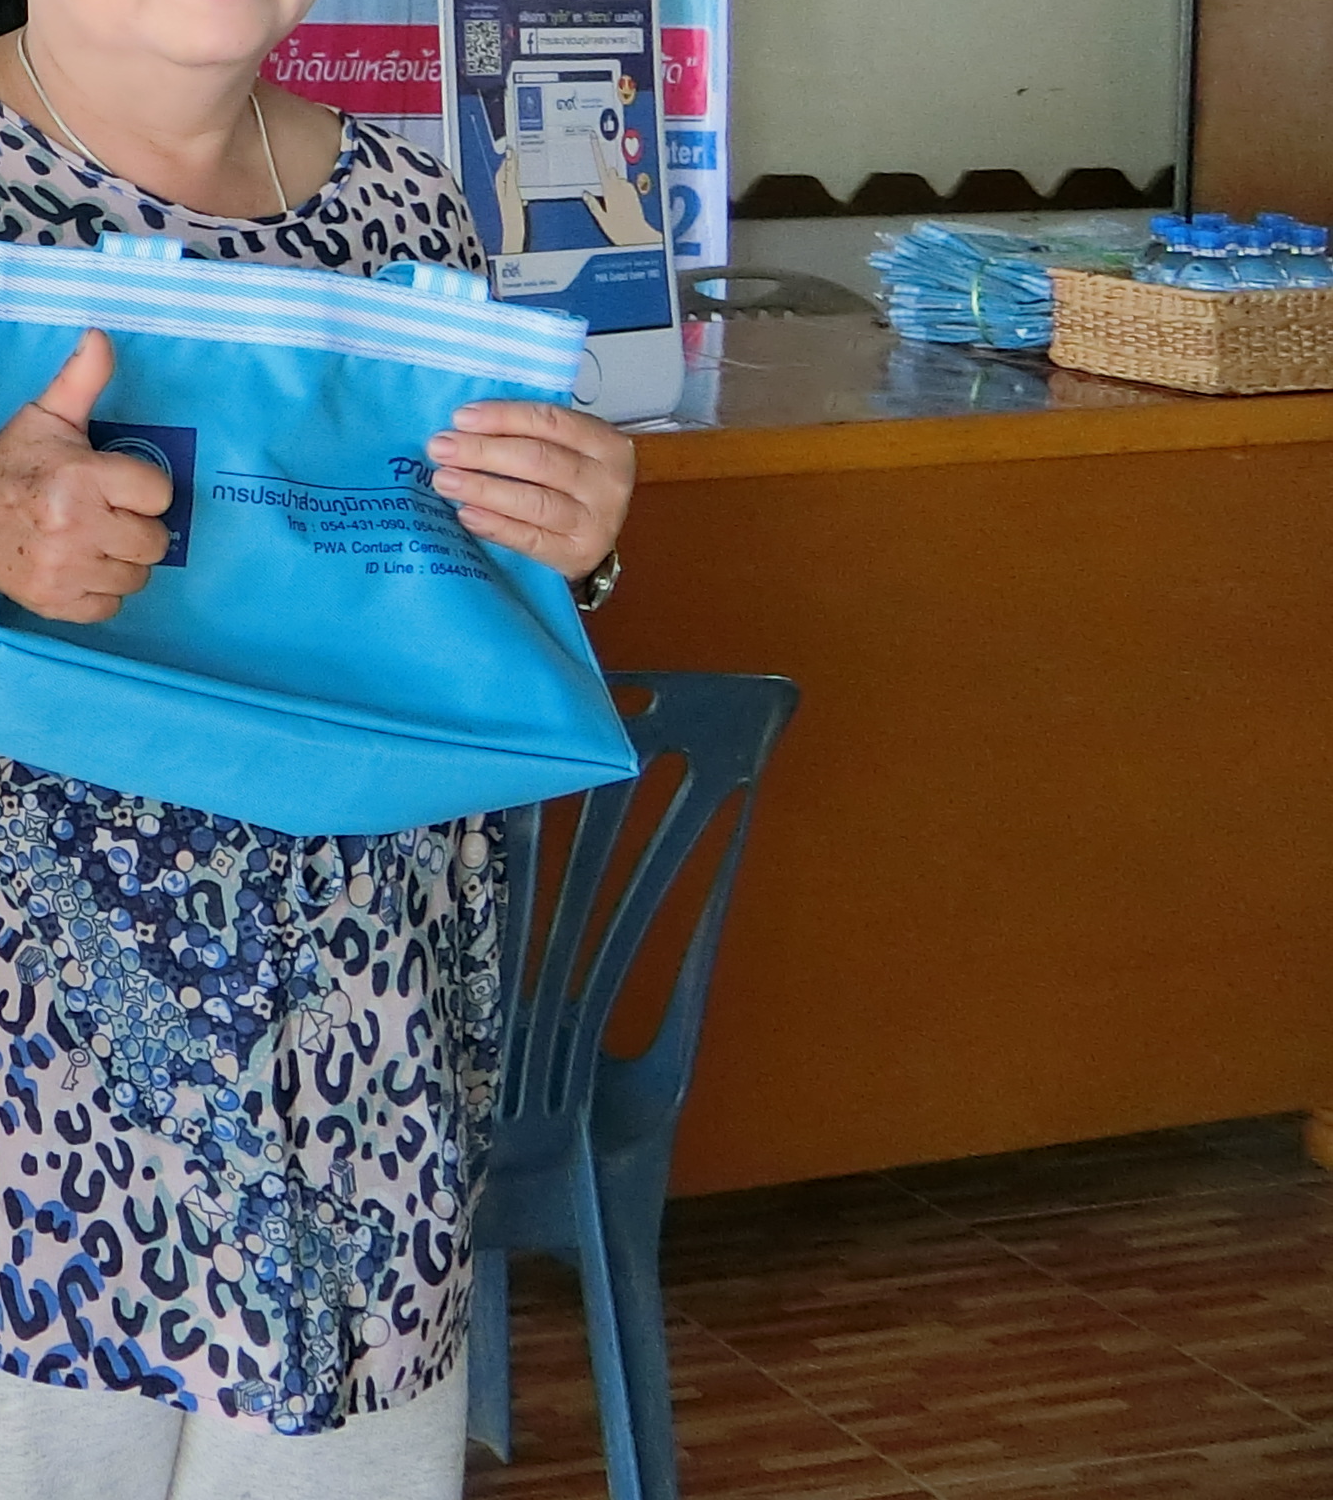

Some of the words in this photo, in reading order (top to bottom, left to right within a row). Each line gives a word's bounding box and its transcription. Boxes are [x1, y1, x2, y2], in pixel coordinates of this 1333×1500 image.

[314, 541, 346, 554] PWA
[351, 541, 403, 554] Contact
[365, 561, 379, 574] ID
[384, 562, 414, 574] Line
